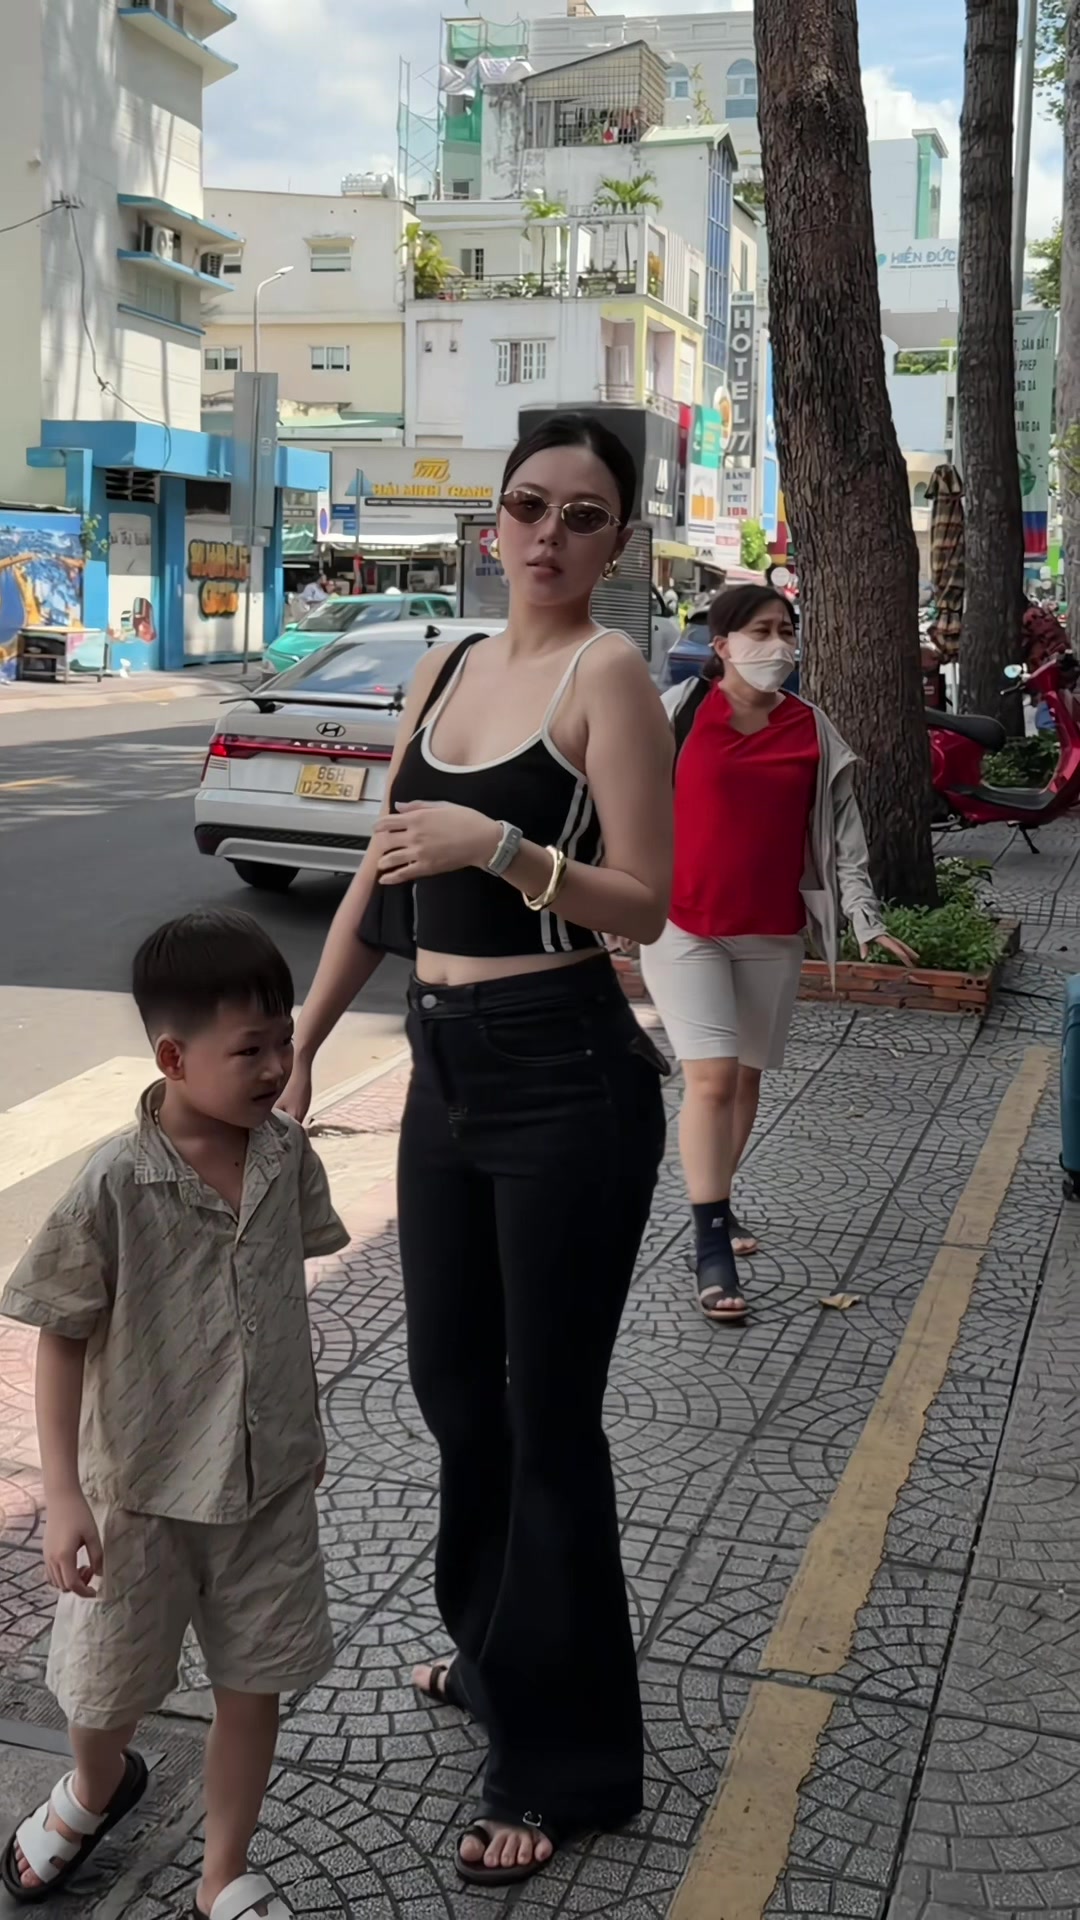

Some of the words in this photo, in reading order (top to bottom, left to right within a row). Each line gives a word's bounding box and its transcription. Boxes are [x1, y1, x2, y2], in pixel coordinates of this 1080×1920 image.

[732, 309, 751, 424] HOTEL
[403, 484, 440, 497] MINH
[293, 741, 369, 751] ACCENT
